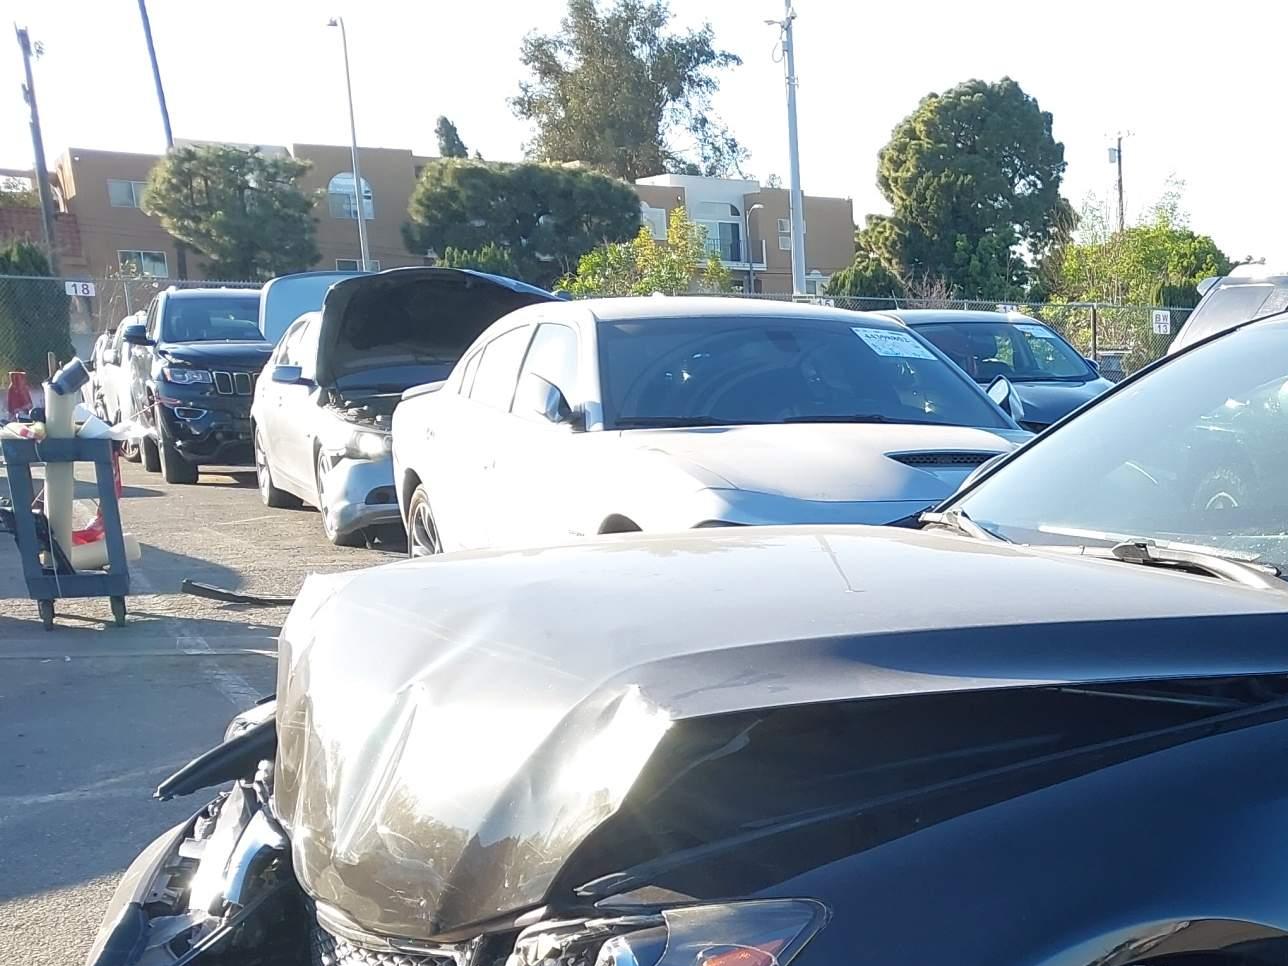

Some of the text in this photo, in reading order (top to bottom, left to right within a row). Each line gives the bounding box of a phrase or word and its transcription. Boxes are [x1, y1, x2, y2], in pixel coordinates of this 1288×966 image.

[71, 283, 90, 295] 18
[1155, 314, 1168, 322] BW
[1157, 325, 1168, 334] 13
